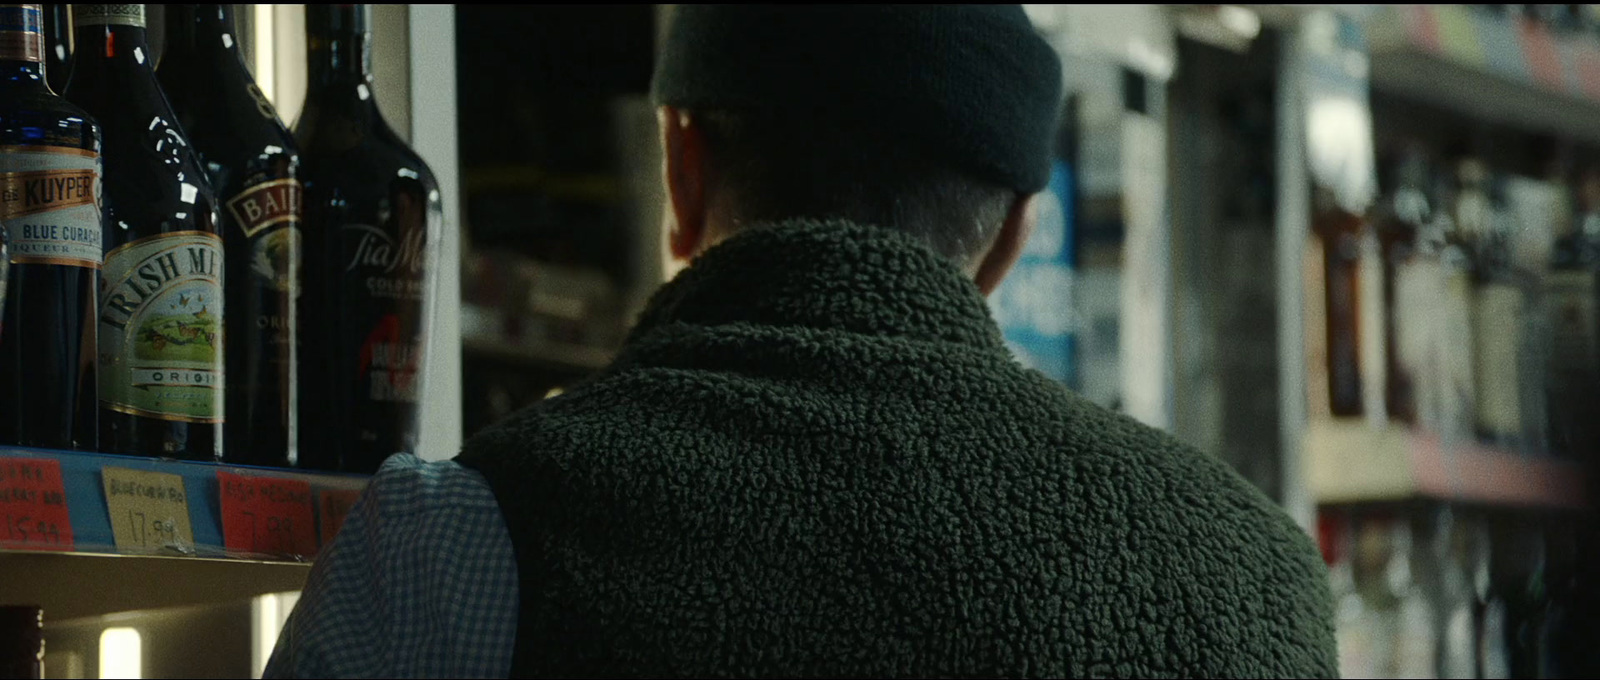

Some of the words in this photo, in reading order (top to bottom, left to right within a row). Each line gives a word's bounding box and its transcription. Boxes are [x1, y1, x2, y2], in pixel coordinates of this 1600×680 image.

[25, 175, 91, 207] KUYPER
[12, 244, 69, 253] IQUEUR
[23, 224, 58, 240] BLUE
[341, 223, 399, 272] Tia
[100, 252, 181, 331] IRISH
[128, 509, 175, 548] 17.99
